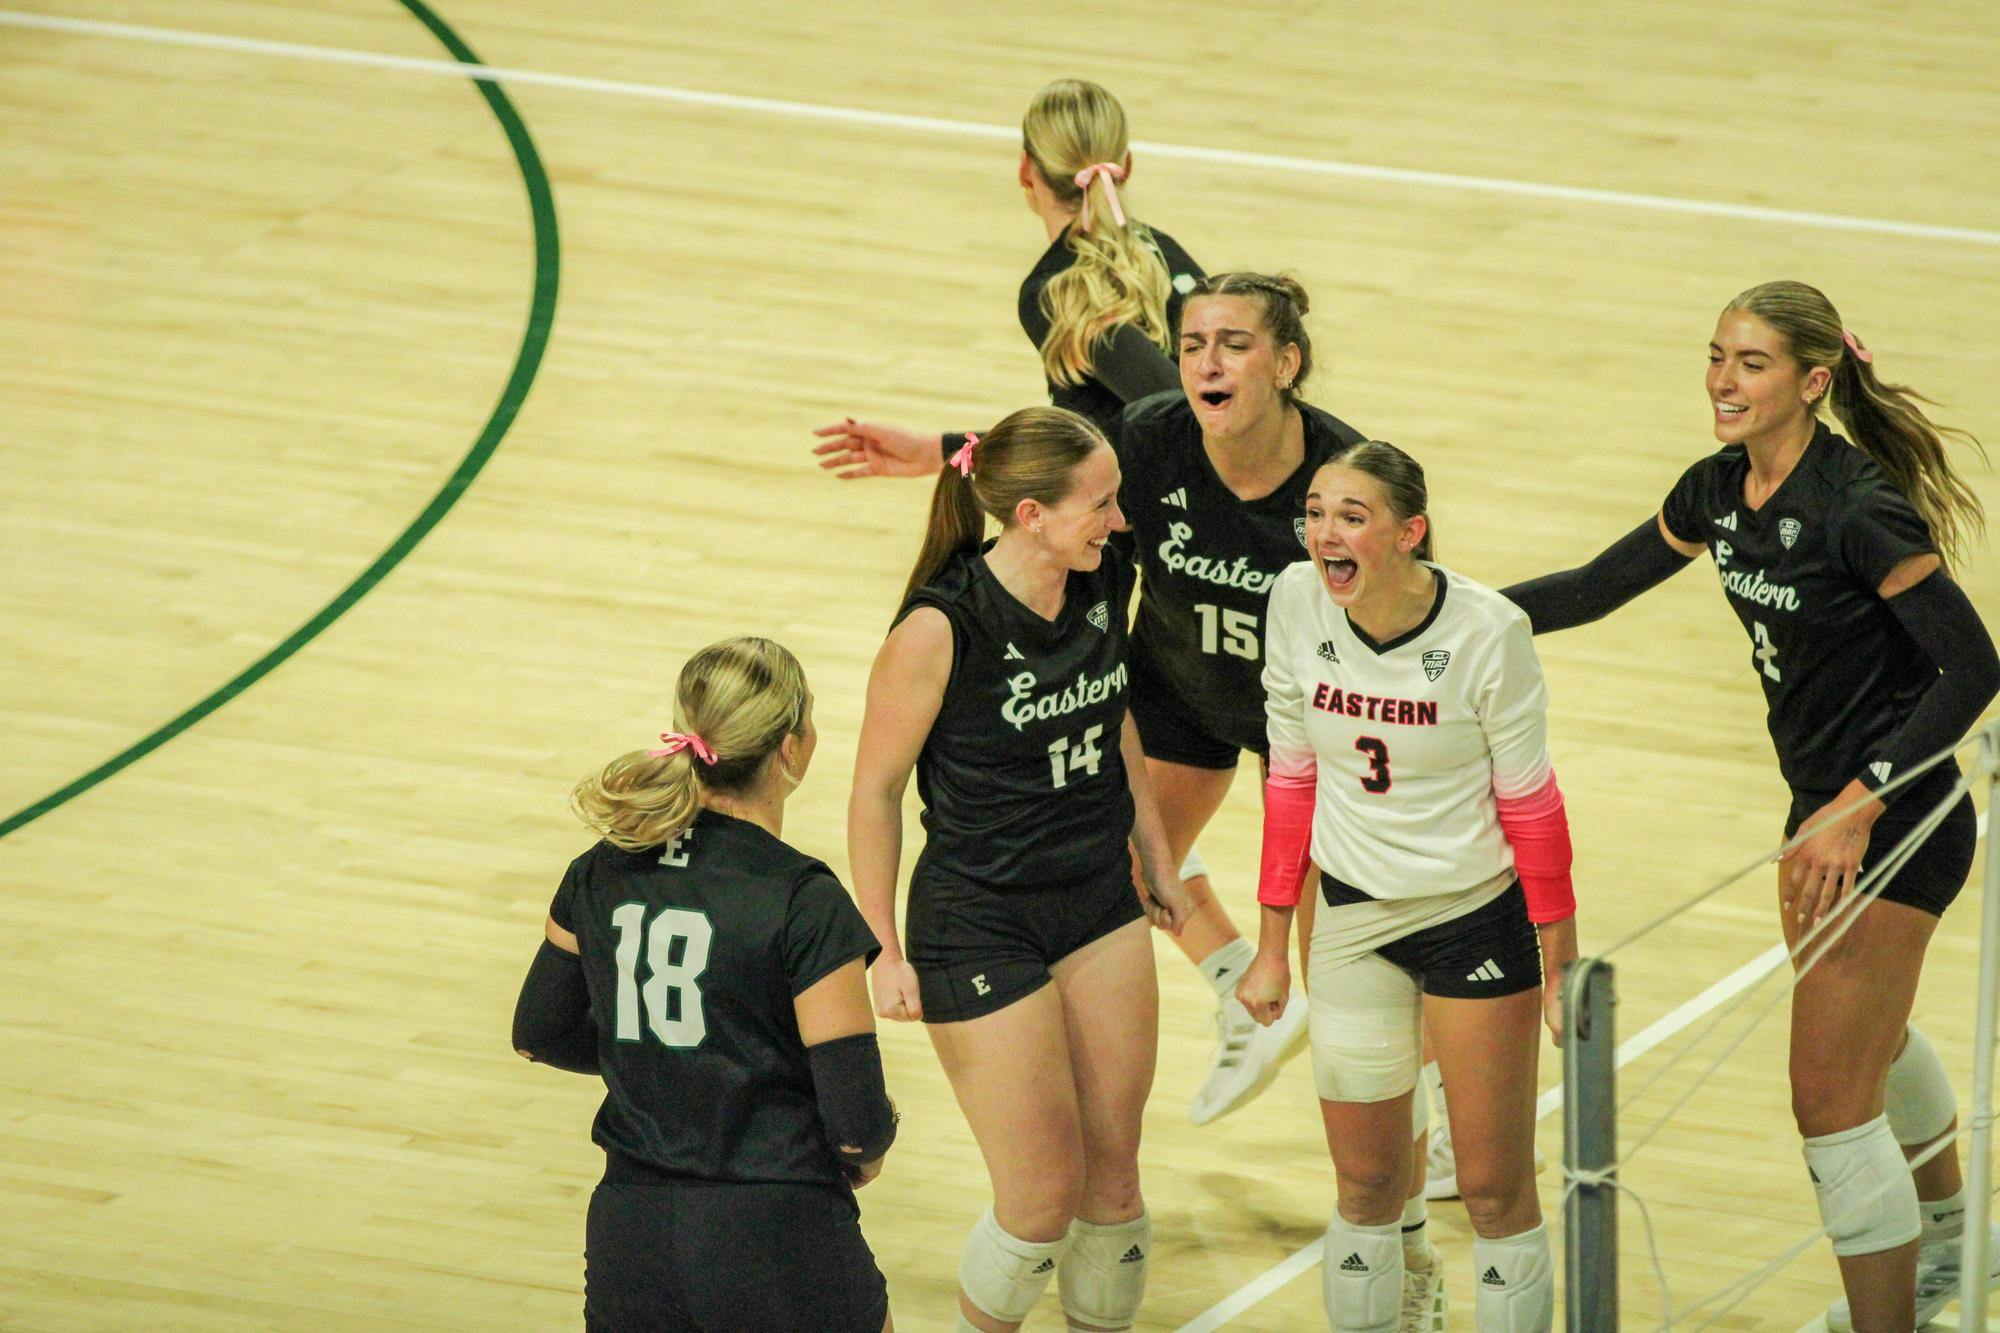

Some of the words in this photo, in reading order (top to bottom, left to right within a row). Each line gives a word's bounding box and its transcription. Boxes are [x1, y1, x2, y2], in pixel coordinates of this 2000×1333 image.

[1158, 521, 1277, 594] Easter
[1194, 603, 1260, 661] 15
[1001, 662, 1128, 732] Eastern
[1312, 682, 1439, 727] EASTERN
[1048, 723, 1104, 789] 14
[1355, 735, 1393, 795] 3
[657, 827, 694, 868] E
[611, 903, 714, 1048] 18
[971, 974, 991, 996] E
[1340, 1263, 1370, 1272] adidas
